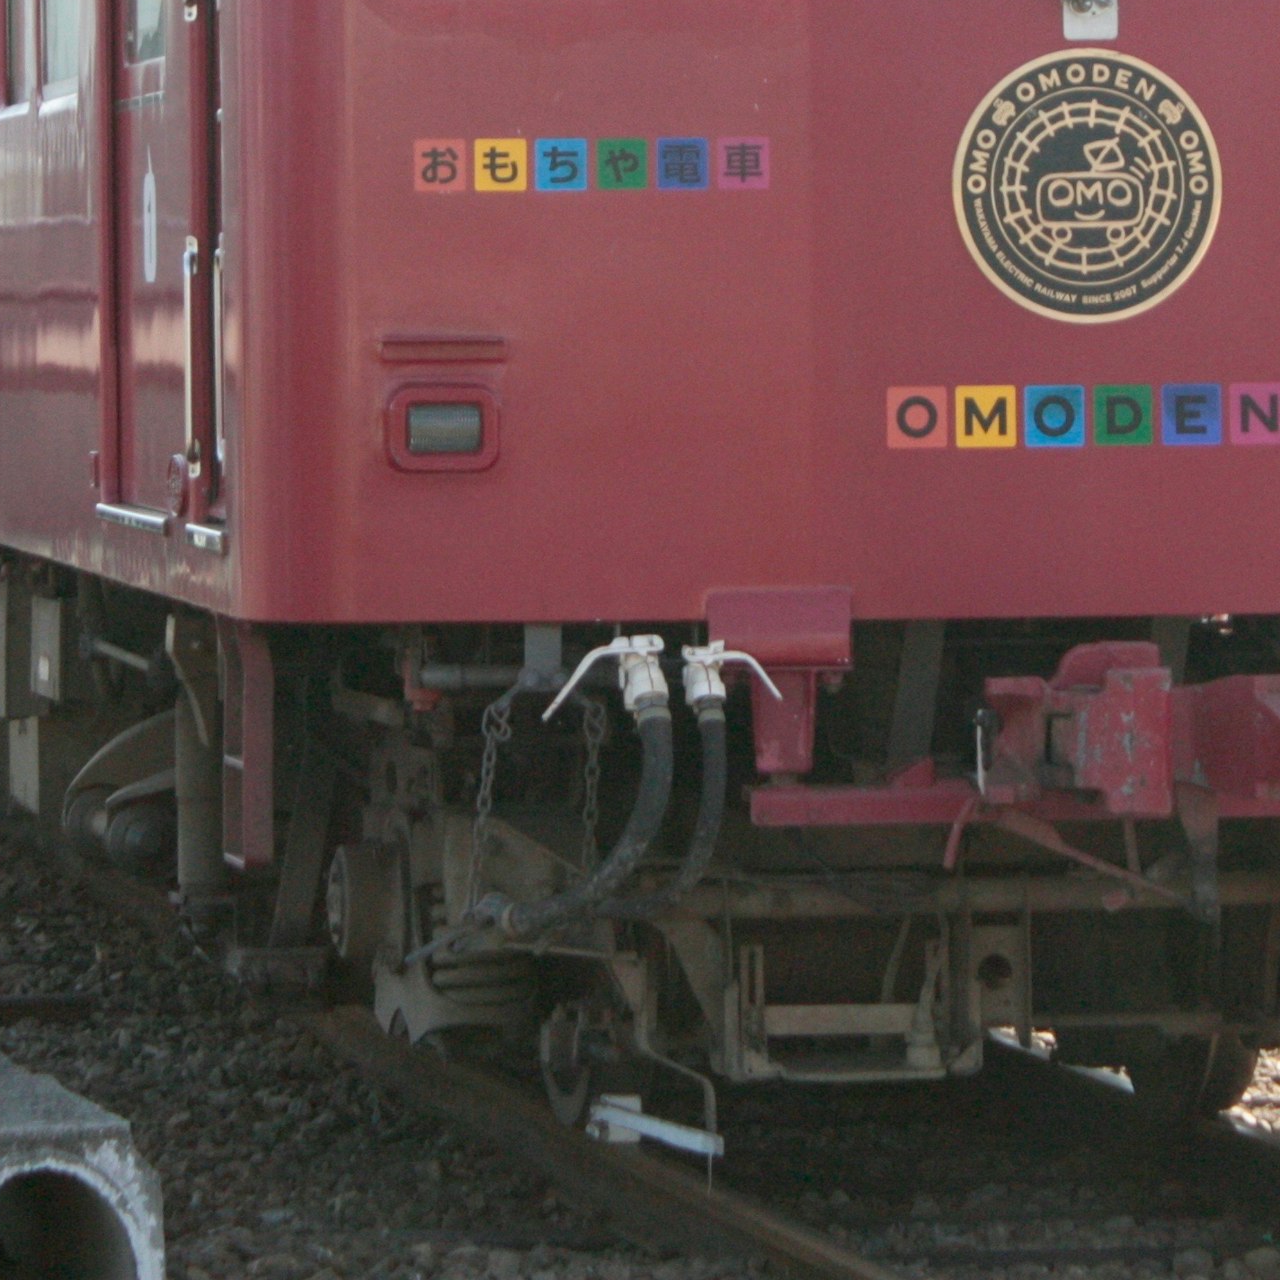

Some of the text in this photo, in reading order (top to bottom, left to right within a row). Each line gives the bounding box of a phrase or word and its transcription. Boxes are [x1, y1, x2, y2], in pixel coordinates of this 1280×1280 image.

[1016, 63, 1157, 102] OMODEN
[967, 129, 996, 195] OMO
[1179, 130, 1209, 195] OMO
[1048, 180, 1133, 207] OMO
[1033, 282, 1077, 302] RAILWAY
[896, 393, 1279, 439] OMODEN
